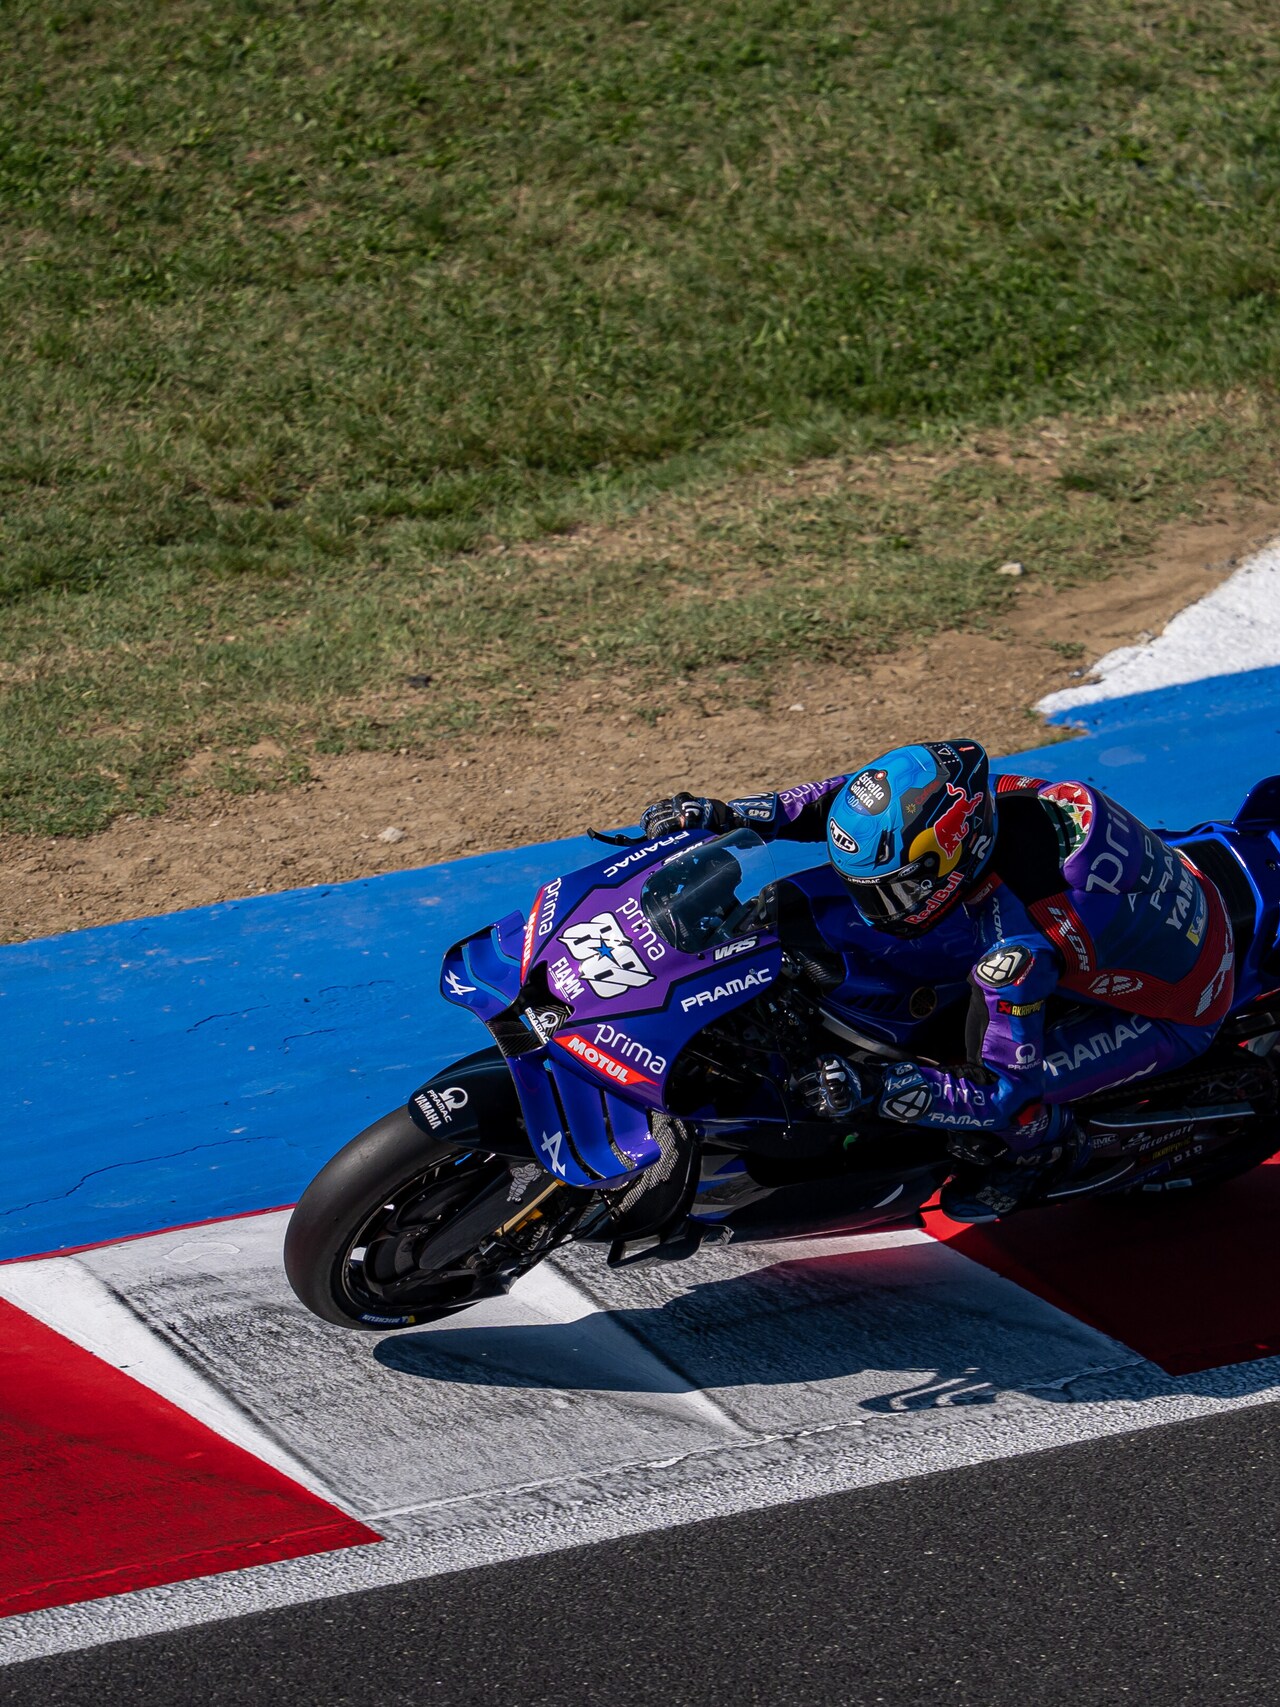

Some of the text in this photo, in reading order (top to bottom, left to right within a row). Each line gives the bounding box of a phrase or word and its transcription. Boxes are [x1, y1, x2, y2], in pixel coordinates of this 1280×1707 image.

[850, 780, 875, 808] Galicia
[858, 771, 885, 800] Estrella
[603, 831, 690, 878] PRAMAC
[538, 878, 562, 936] prima
[904, 898, 940, 925] Red
[932, 870, 965, 903] Bull
[615, 897, 666, 961] prima
[715, 936, 759, 961] WRS
[551, 956, 586, 1001] FIAMM
[680, 968, 773, 1012] PRAMAC
[524, 1007, 550, 1044] PRAMAC
[567, 1037, 629, 1084] MOTUL
[593, 1023, 667, 1075] prima
[414, 1093, 443, 1130] YAMAHA
[426, 1089, 453, 1124] PRAMAC
[928, 1111, 995, 1127] RAMAC
